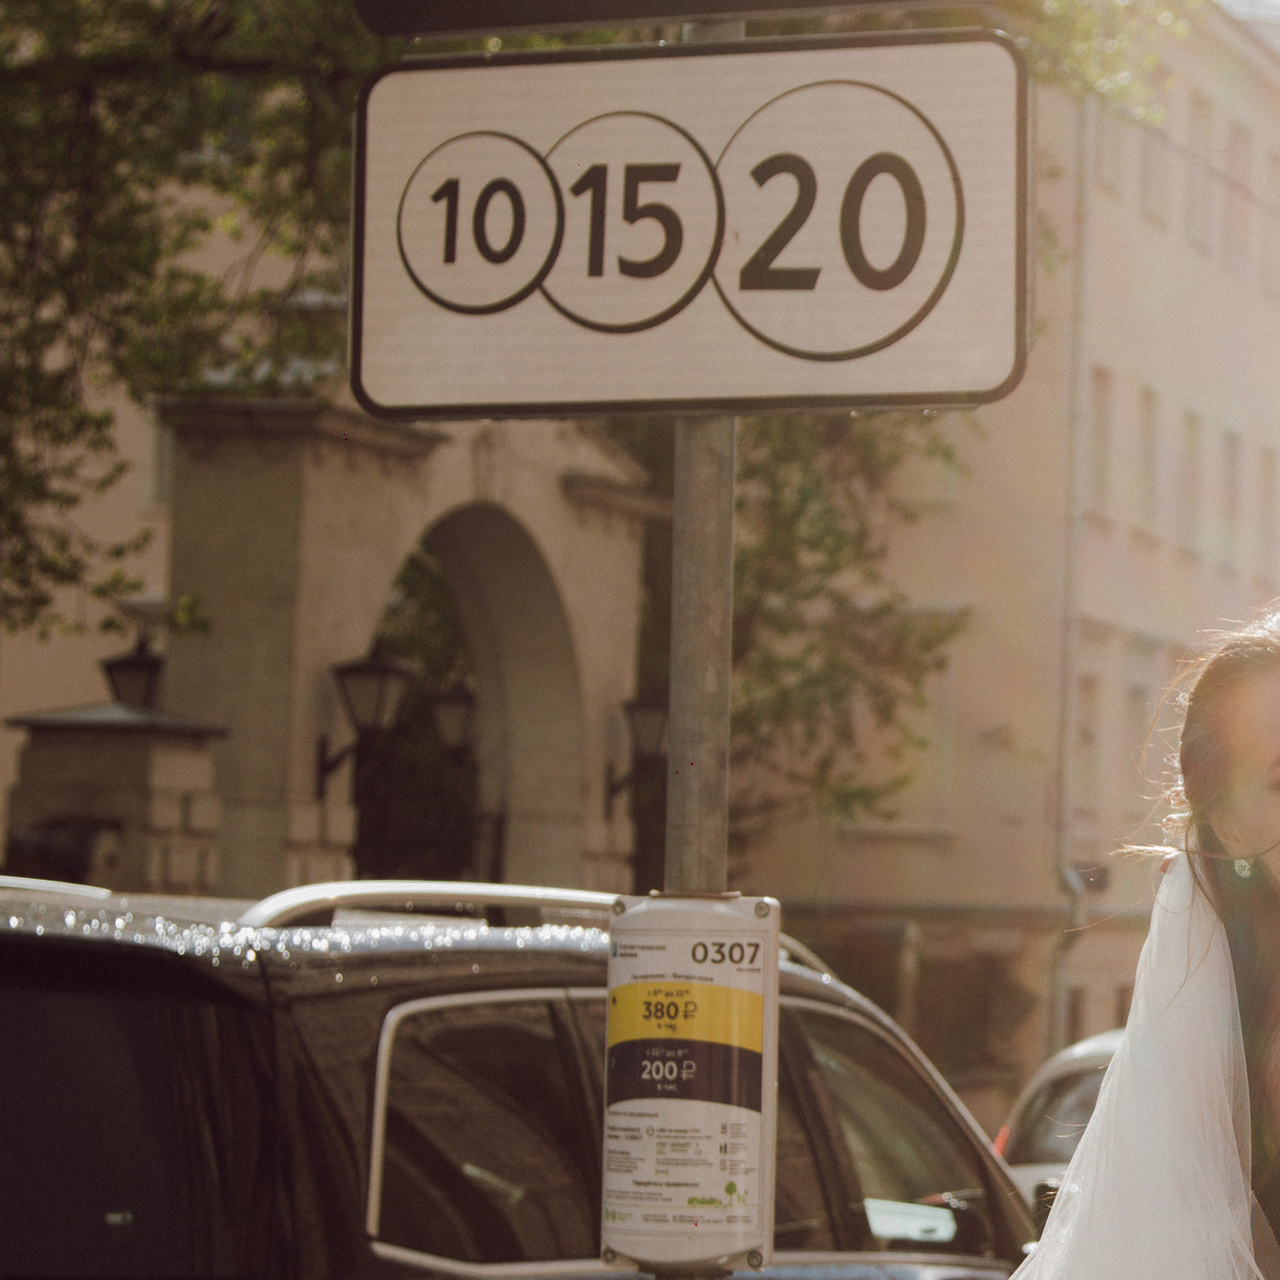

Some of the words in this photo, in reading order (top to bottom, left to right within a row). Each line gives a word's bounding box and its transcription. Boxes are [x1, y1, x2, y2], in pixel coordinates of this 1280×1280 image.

[430, 176, 527, 265] 10
[569, 161, 684, 280] 15
[738, 150, 927, 292] 20
[691, 941, 761, 965] 0307
[642, 1000, 679, 1020] 380
[641, 1059, 678, 1081] 200
